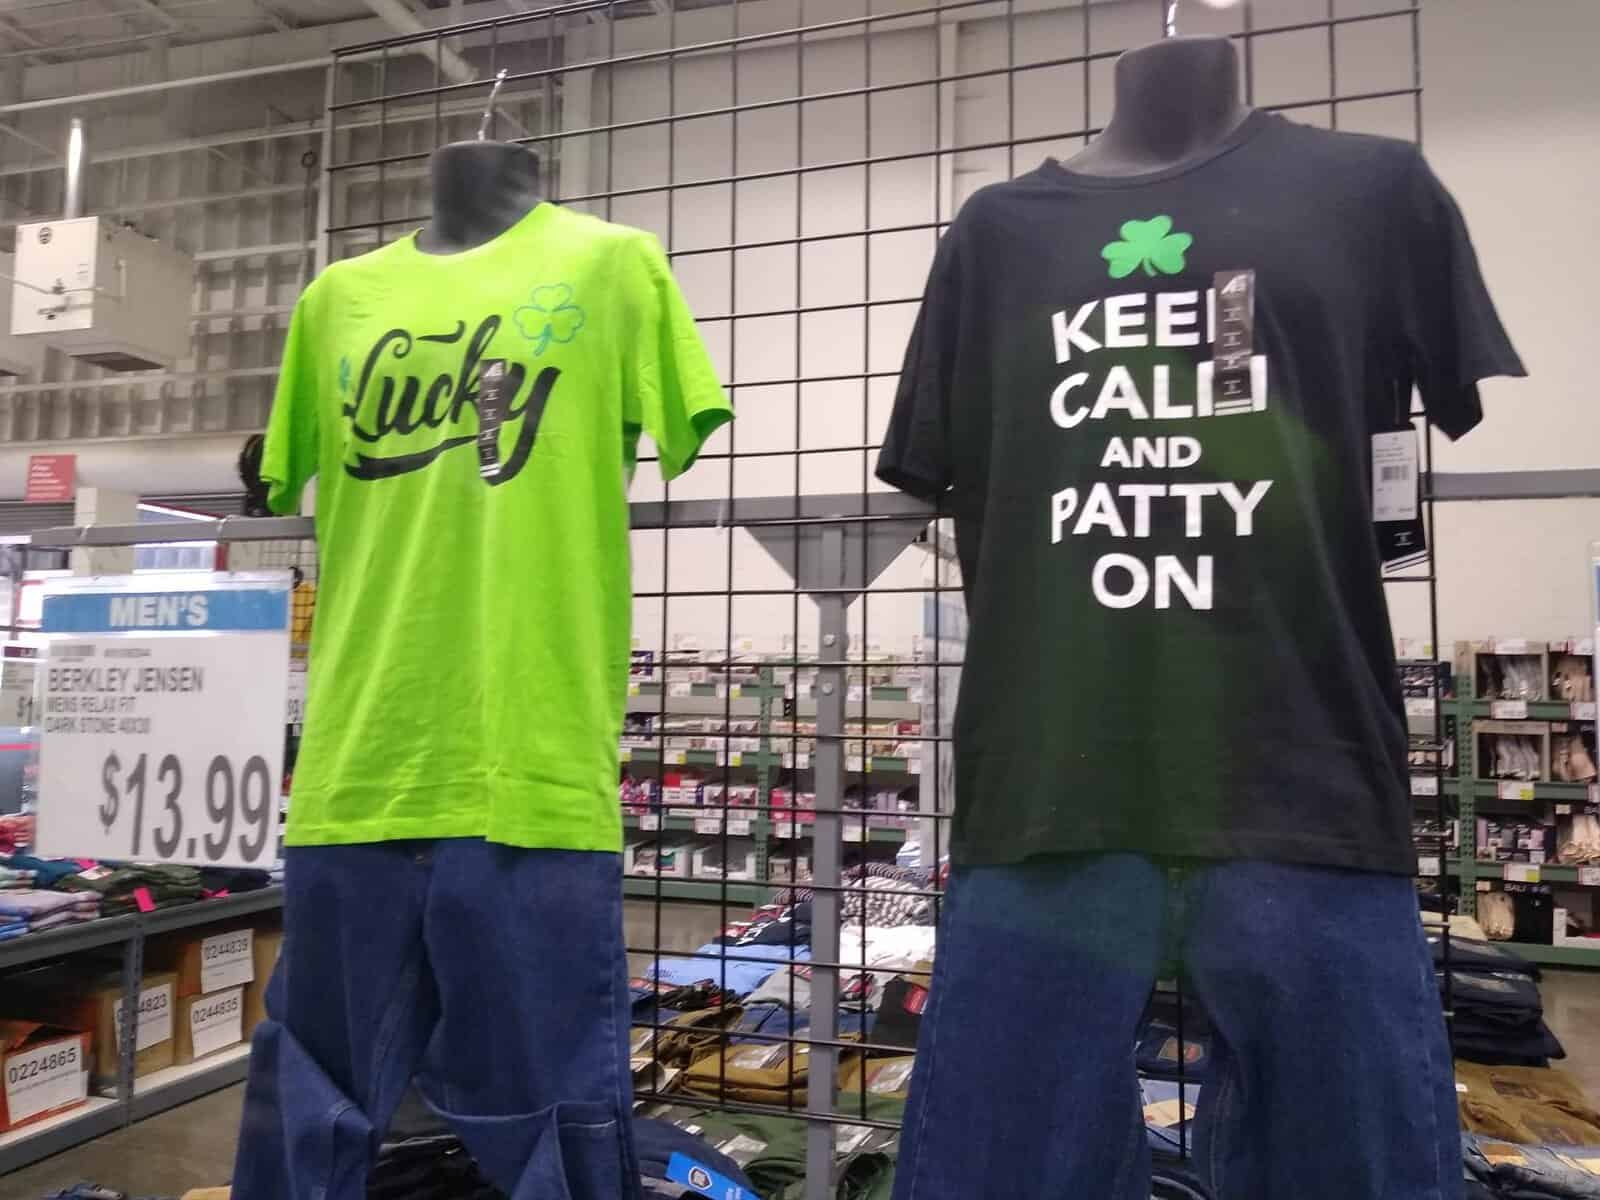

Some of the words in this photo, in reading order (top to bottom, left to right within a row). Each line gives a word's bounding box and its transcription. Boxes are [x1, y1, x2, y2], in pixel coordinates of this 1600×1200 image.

[1051, 289, 1216, 364] KEE
[1101, 436, 1202, 468] AND
[1051, 480, 1273, 544] PATTY
[1091, 553, 1214, 610] ON
[110, 595, 208, 627] MEN'S
[49, 667, 129, 692] BERKLEY
[133, 667, 205, 692] JENSEN
[99, 750, 271, 863] $13.99
